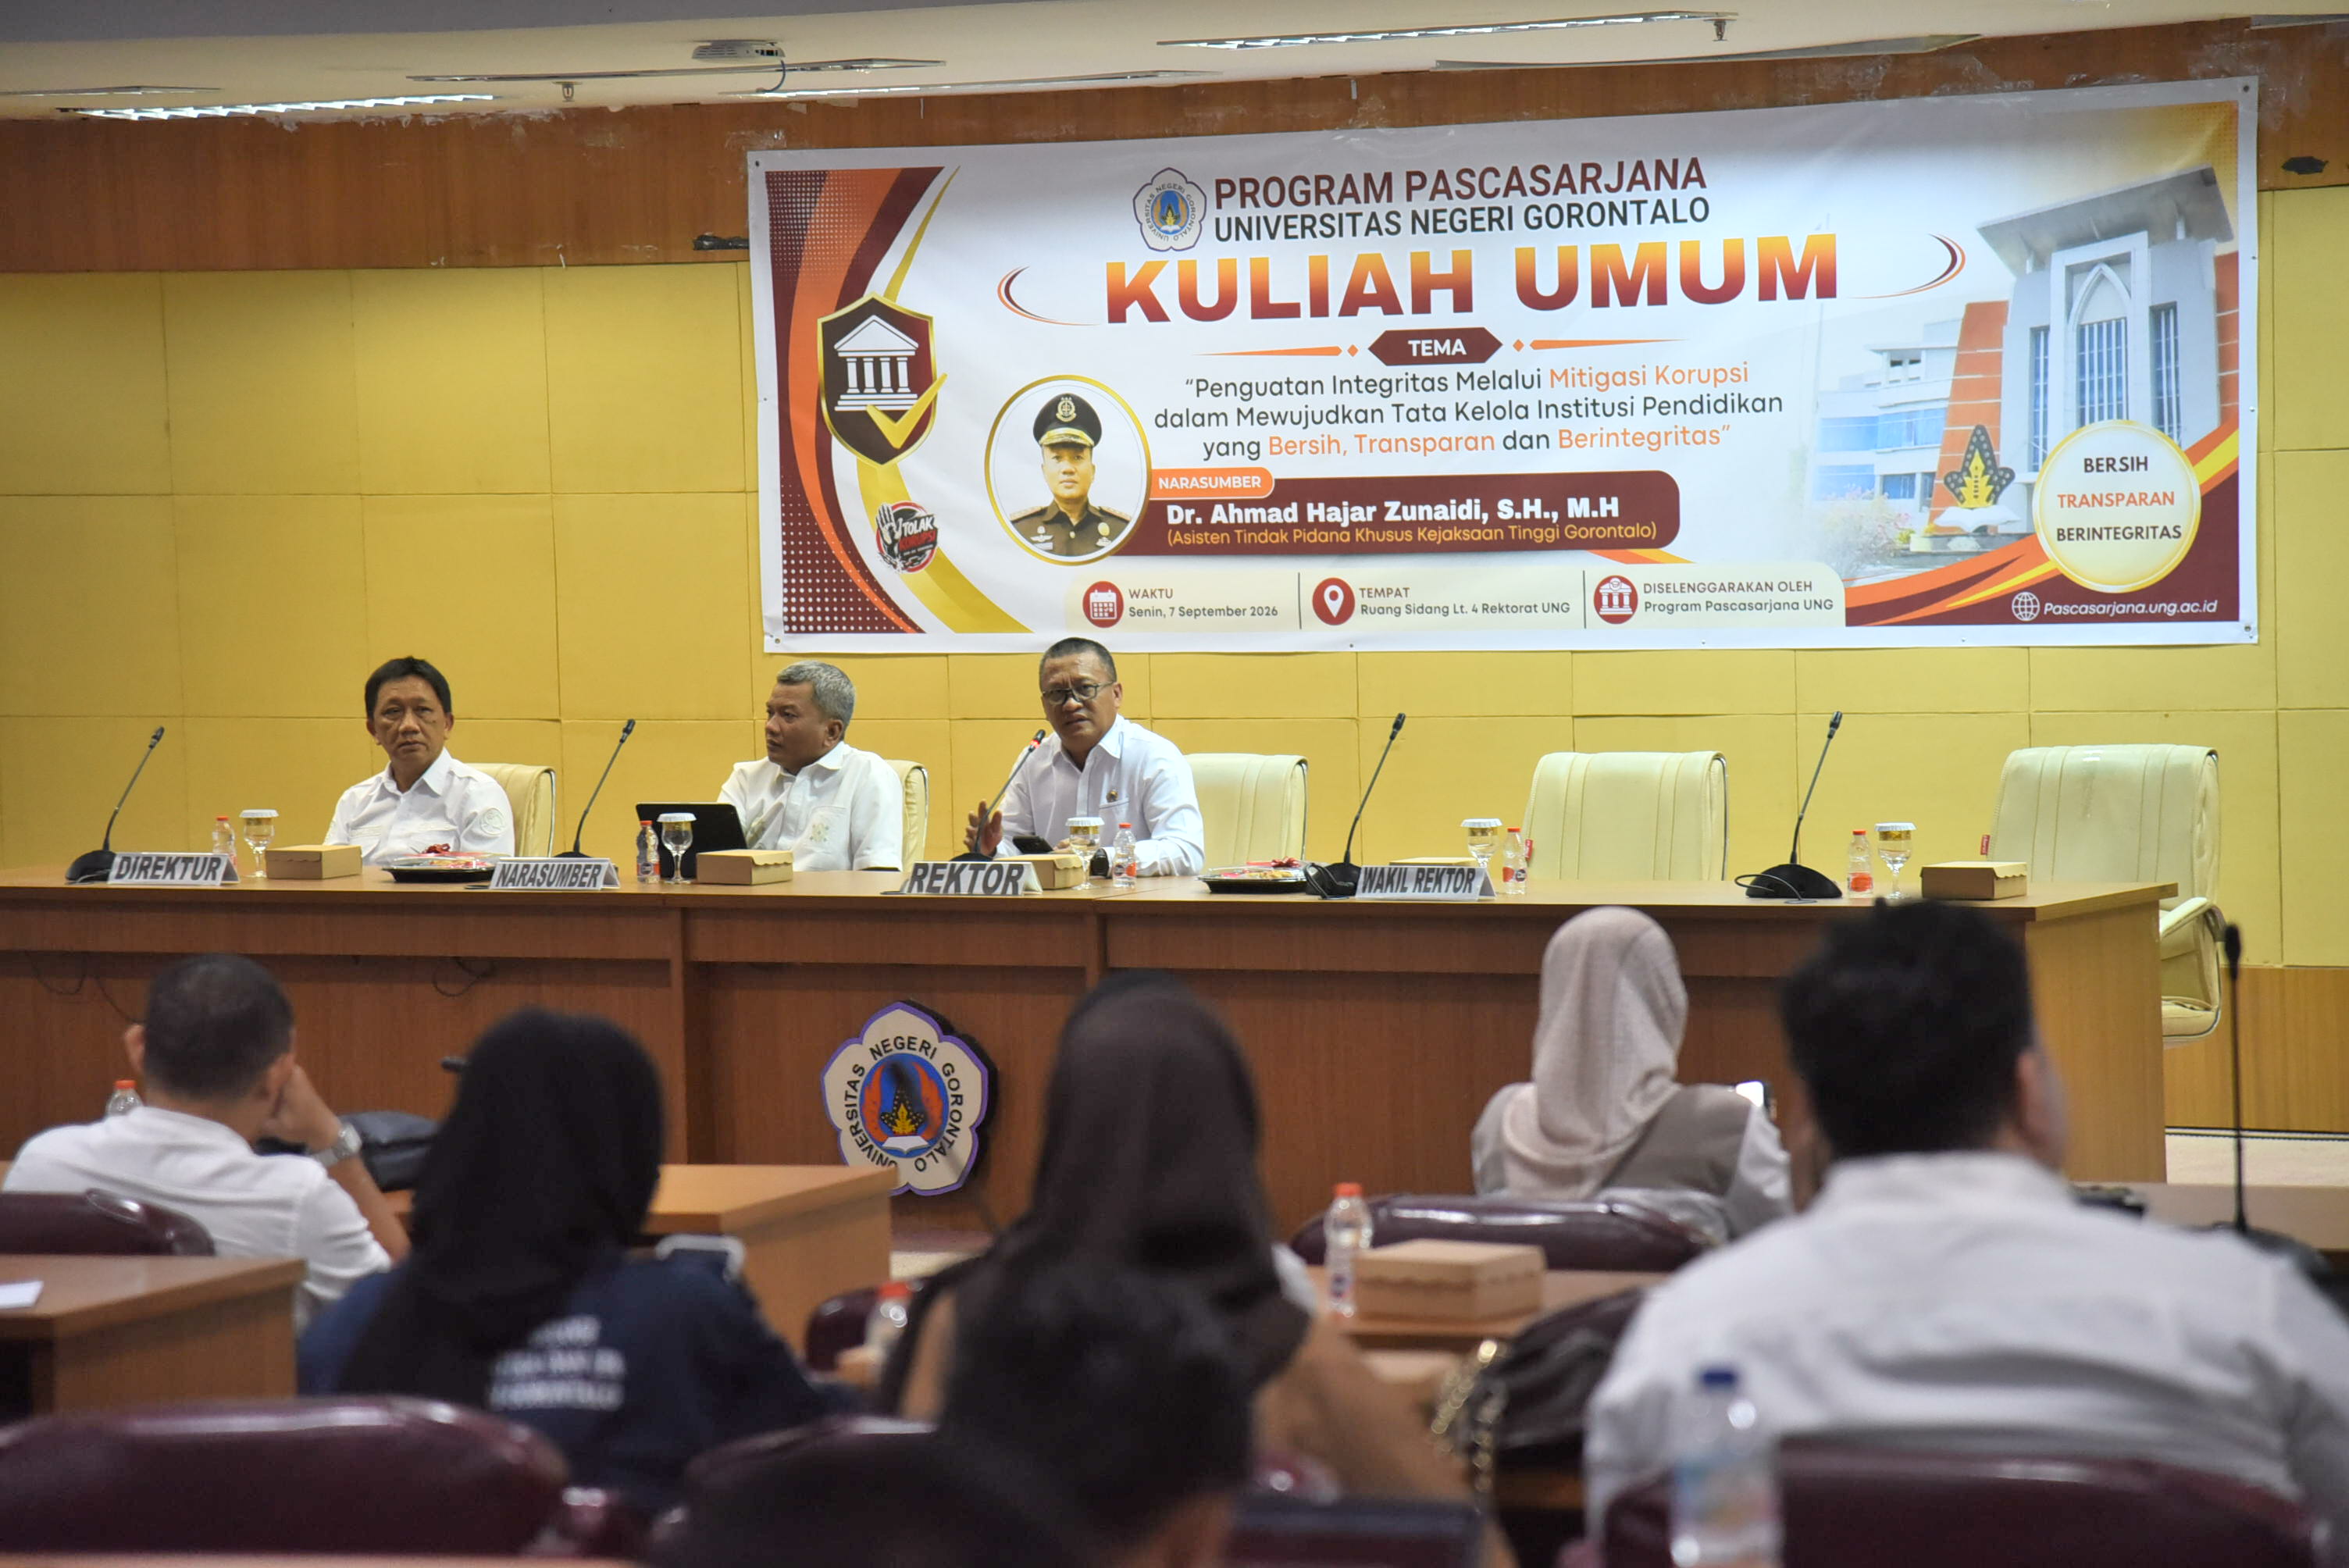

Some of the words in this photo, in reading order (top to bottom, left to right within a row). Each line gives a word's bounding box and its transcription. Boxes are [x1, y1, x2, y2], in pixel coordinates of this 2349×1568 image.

[1156, 183, 1185, 194] NEGERI
[1215, 172, 1393, 209] PROGRAM
[1406, 157, 1707, 202] PASCASARJANA
[1145, 193, 1169, 241] UNIVERSITAS
[1173, 194, 1196, 241] GORONTALO
[1215, 209, 1402, 242] UNIVERSITAS
[1411, 205, 1513, 235] NEGERI
[1524, 196, 1710, 230] GORONTALO
[1106, 249, 1474, 323] KULIAH
[1515, 233, 1838, 311] UMUM
[1407, 338, 1467, 357] TEMA
[1332, 372, 1449, 400] Integritas
[1456, 369, 1542, 391] Melalui
[1549, 364, 1647, 393] Mitigasi
[1655, 361, 1749, 389] Korupsi
[1154, 408, 1228, 428] dalam
[1236, 404, 1385, 429] Mewujudkan
[1392, 403, 1447, 423] Tata
[1455, 400, 1529, 422] Kelola
[1538, 396, 1635, 419] Institusi
[1643, 393, 1783, 416] Pendidikan
[1203, 440, 1261, 461] yang
[1268, 435, 1349, 456] Bersih,
[1353, 433, 1495, 457] Transparan
[1502, 429, 1550, 451] dan
[2083, 456, 2149, 473] BERSIH
[1158, 476, 1262, 490] NARASUMBER
[2057, 491, 2176, 508] TRANSPARAN
[1166, 504, 1203, 525] Dr.
[1210, 502, 1299, 524] Ahmad
[1306, 501, 1378, 528] Hajar
[1384, 498, 1489, 525] Zunaidi,
[1496, 497, 1559, 523] S.H.,
[1567, 497, 1620, 518] M.H
[902, 516, 934, 537] TOLAK
[1167, 529, 1231, 547] (Asisten
[1234, 528, 1289, 544] Tindak
[1292, 527, 1351, 543] Pidana
[1355, 526, 1413, 543] Khusus
[1417, 525, 1505, 545] Kejaksaan
[1508, 524, 1560, 543] Tinggi
[1564, 522, 1657, 540] Gorontalo)
[2056, 525, 2182, 541] BERINTEGRITAS
[1128, 588, 1174, 600] WAKTU
[1359, 587, 1410, 599] TEMPAT
[1643, 581, 1773, 593] DISELENGGARAKAN
[1777, 580, 1813, 592] OLEH
[1128, 606, 1167, 618] Senin,
[1169, 607, 1175, 617] 7
[1178, 605, 1247, 619] September
[1249, 606, 1278, 617] 2026
[1360, 604, 1402, 618] Ruang
[1405, 603, 1449, 617] Sidang
[1453, 604, 1468, 614] Lt.
[1471, 604, 1478, 614] 4
[1481, 603, 1538, 615] Rektorat
[1542, 602, 1570, 613] UNG
[1644, 601, 1702, 615] Program
[1706, 600, 1799, 614] Pascasarjana
[1803, 599, 1834, 611] UNG
[2043, 600, 2219, 618] Pascasarjana.ung.ac.id
[116, 856, 222, 881] DIREKTUR
[495, 863, 602, 889] NARASUMBER
[910, 862, 1025, 896] REKTOR
[1361, 867, 1409, 894] WAKIL
[1415, 867, 1477, 894] REKTOR
[869, 1036, 938, 1061] NEGERI
[914, 1063, 964, 1172] GORONTALO
